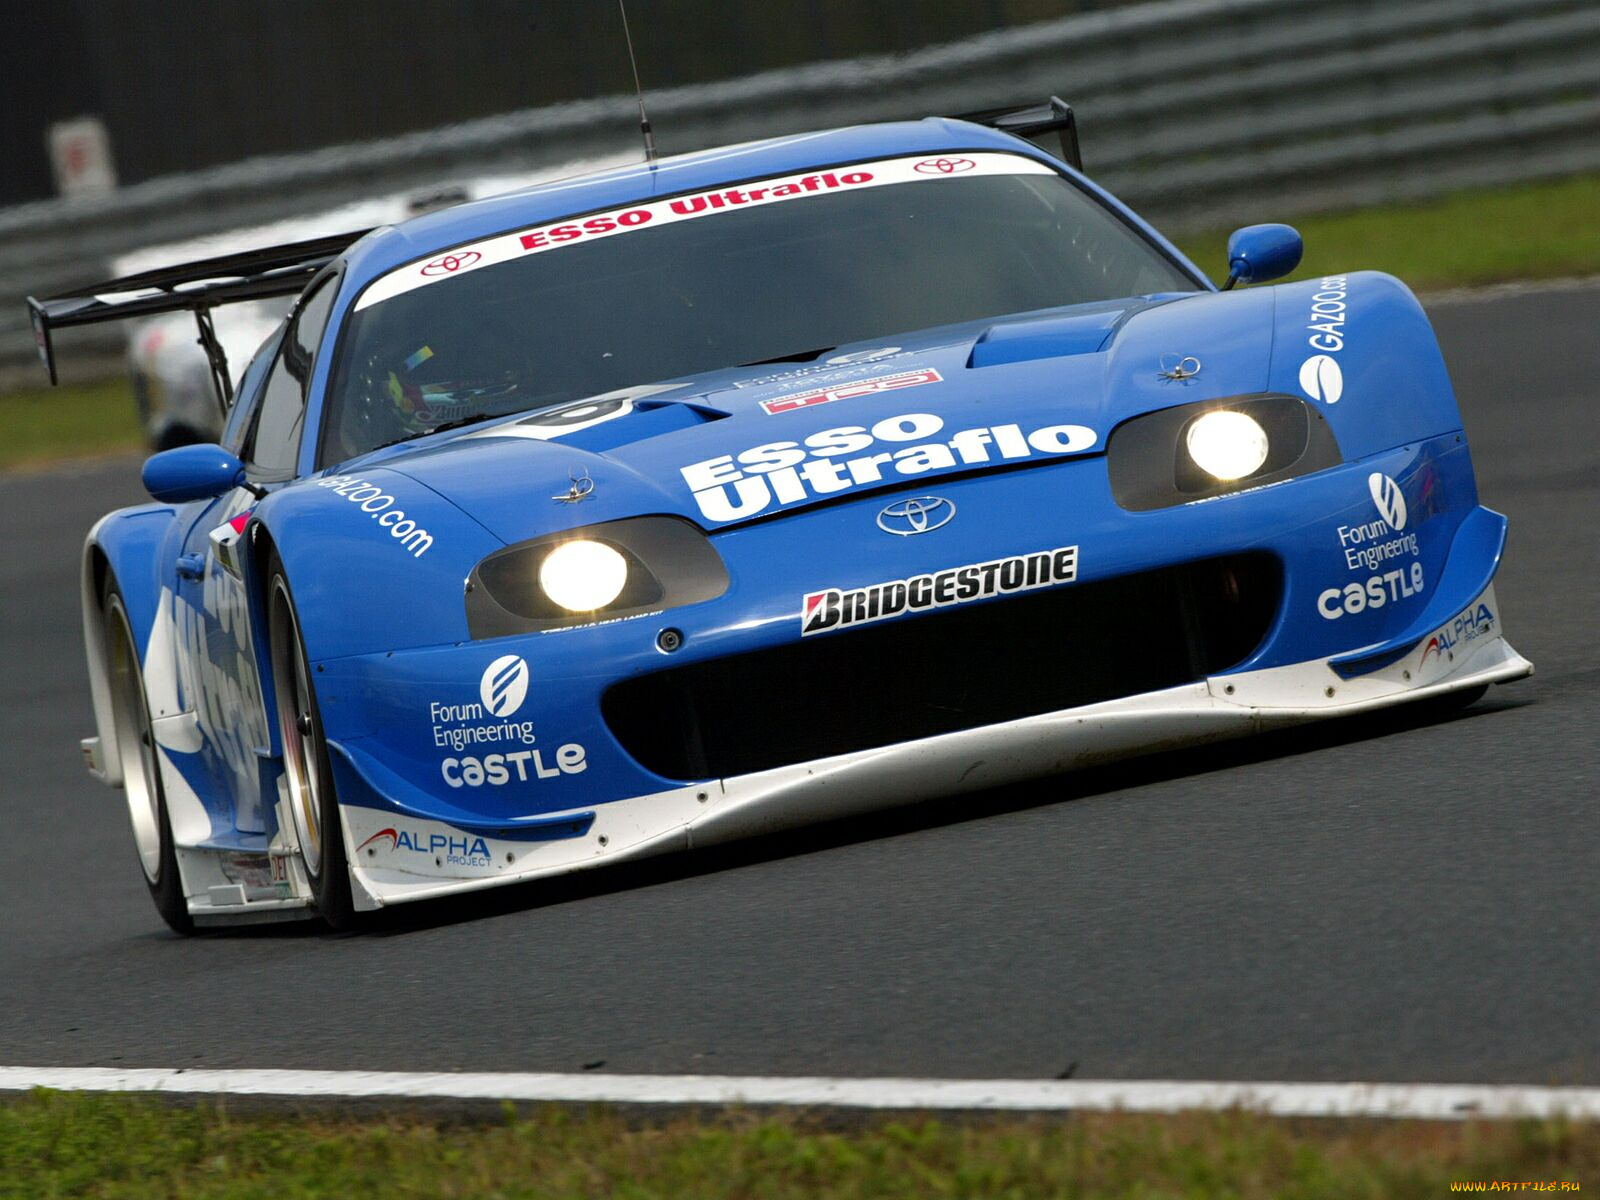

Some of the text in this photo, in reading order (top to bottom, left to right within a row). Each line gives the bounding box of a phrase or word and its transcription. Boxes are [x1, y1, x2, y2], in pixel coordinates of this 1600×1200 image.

[519, 171, 874, 251] ESSO Ultraflo
[680, 413, 944, 492] ESSO
[693, 424, 1098, 522] Ultraflo
[1337, 519, 1389, 547] Forum
[1344, 531, 1420, 571] Engineering
[803, 548, 1075, 634] BRIDGESTONE
[1439, 603, 1494, 651] ALPHA
[430, 702, 483, 723] Forum
[433, 719, 536, 751] Engineering
[396, 831, 491, 858] ALPHA
[446, 855, 492, 867] PROJECT
